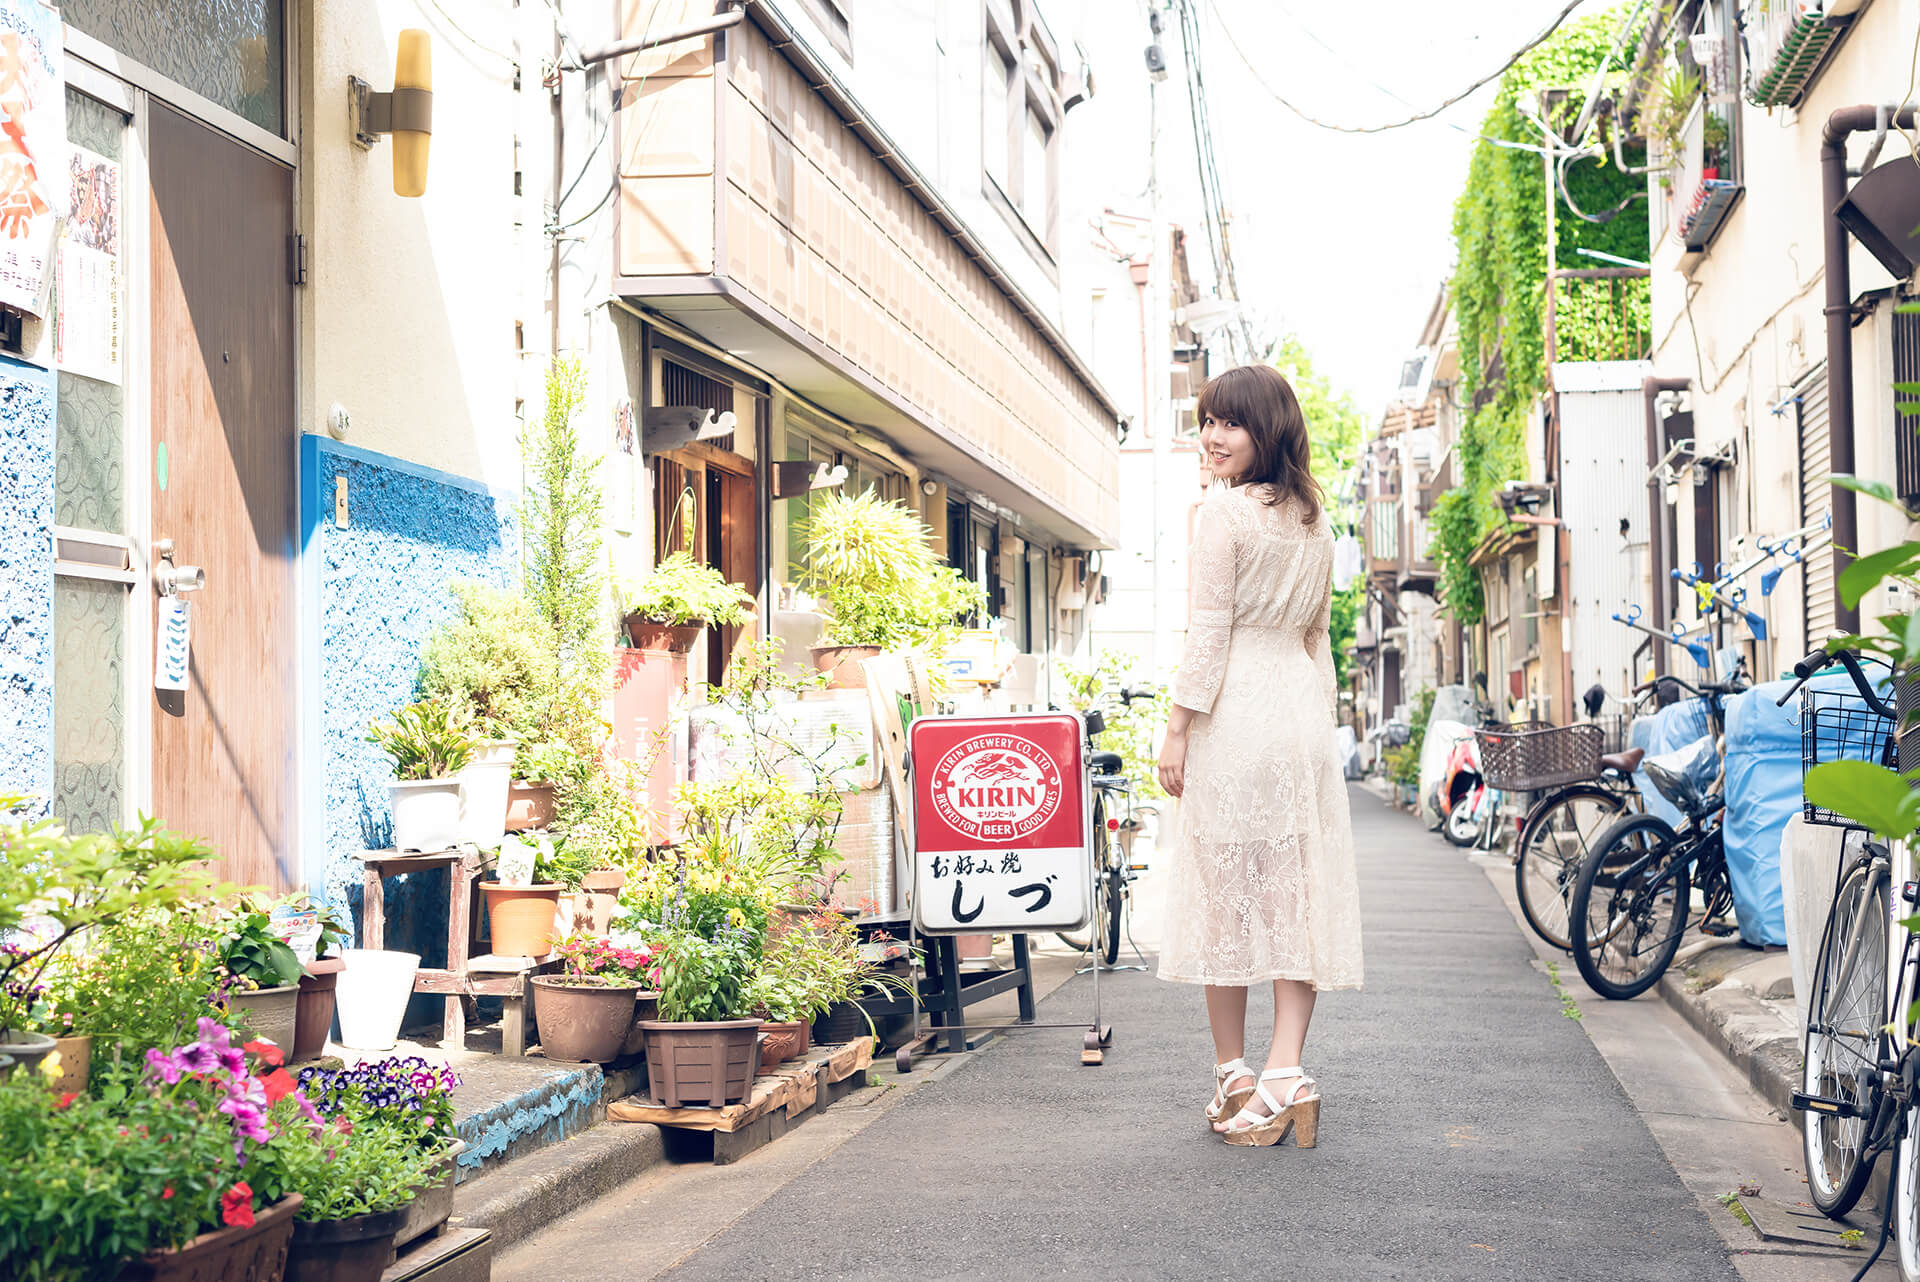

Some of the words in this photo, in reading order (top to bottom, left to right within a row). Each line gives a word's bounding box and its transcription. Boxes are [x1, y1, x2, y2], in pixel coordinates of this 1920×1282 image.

[940, 748, 965, 774] KIRIN
[966, 737, 1014, 753] BREWERY
[958, 786, 1036, 808] KIRIN
[936, 793, 961, 824] BREWED
[959, 819, 977, 834] FOR
[1018, 813, 1044, 832] GOOD
[1039, 790, 1058, 816] TIMES
[976, 810, 1017, 818] キリンビール
[983, 824, 1012, 836] BEER
[930, 852, 1022, 879] お好み焼
